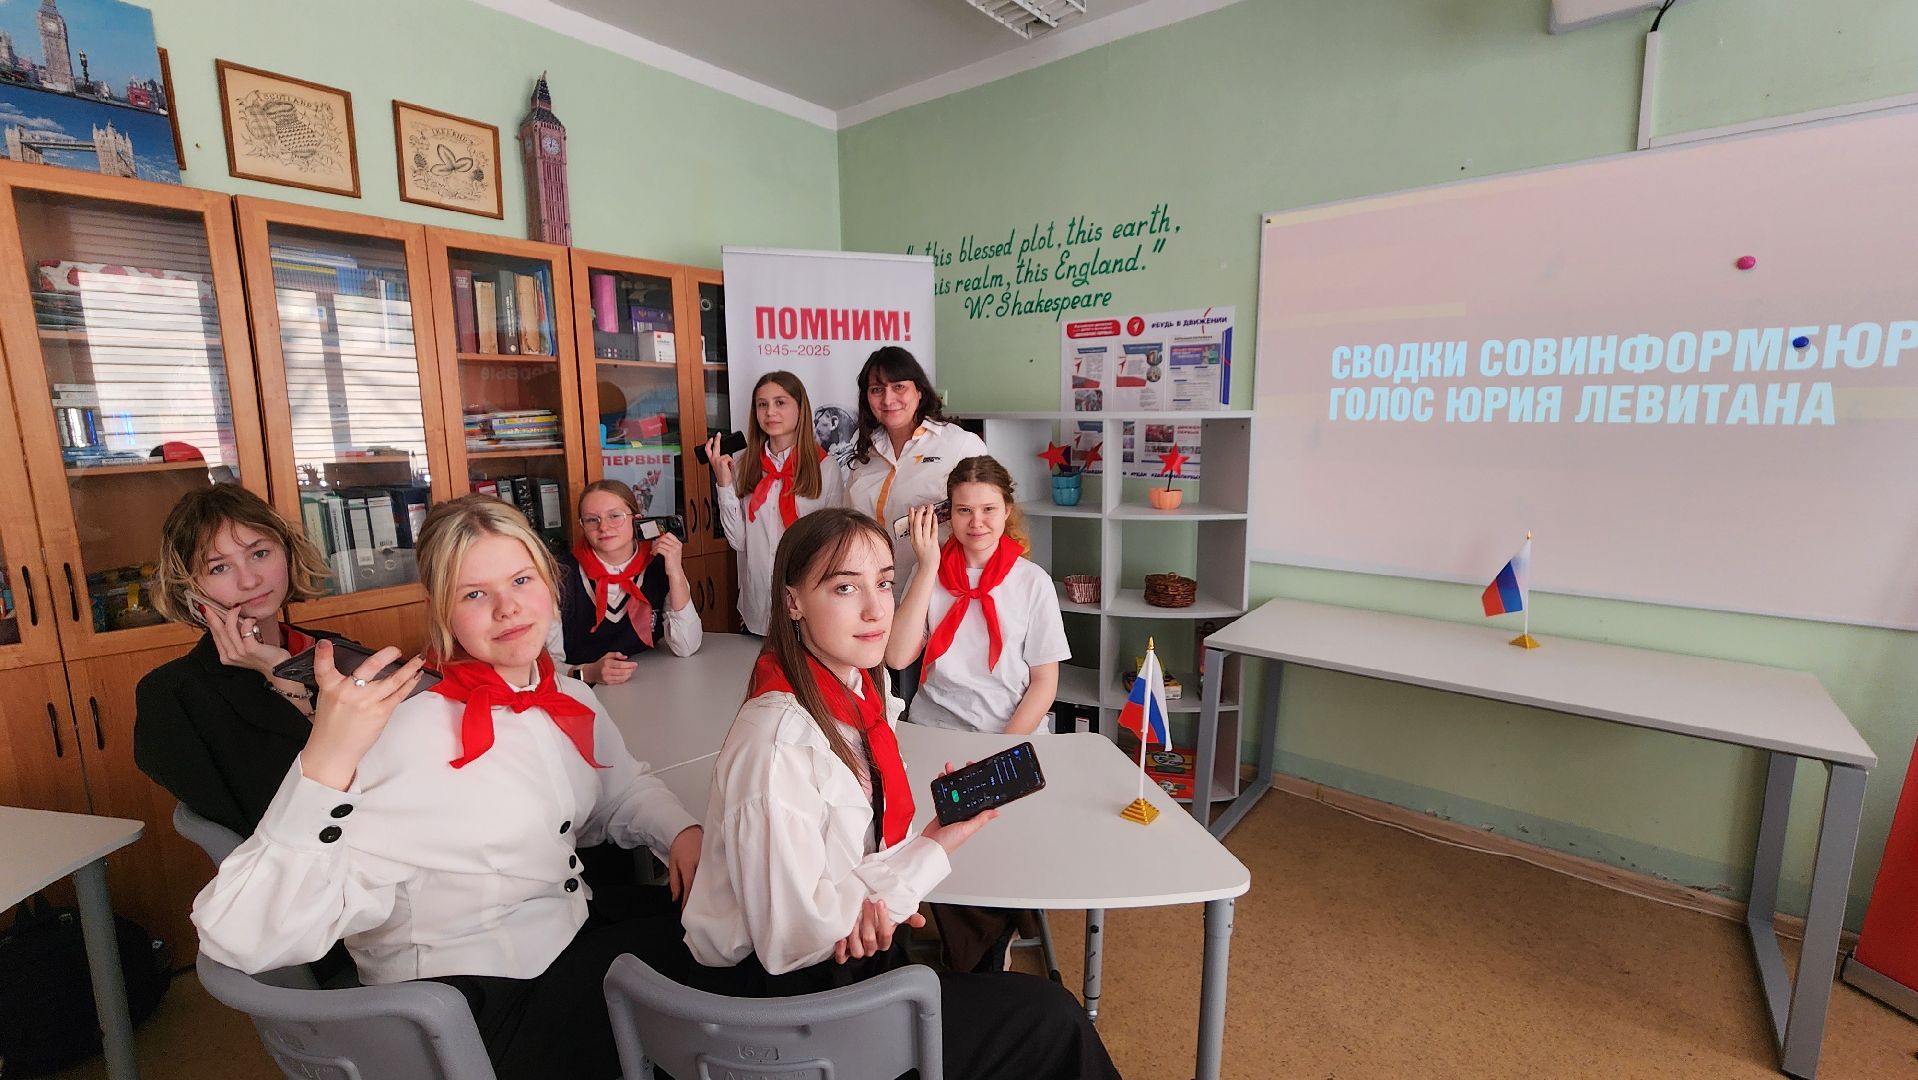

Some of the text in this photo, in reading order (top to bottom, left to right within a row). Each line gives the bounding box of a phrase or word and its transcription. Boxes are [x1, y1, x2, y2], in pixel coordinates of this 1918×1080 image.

[959, 228, 1015, 262] blessed
[1066, 215, 1103, 245] this
[955, 264, 1011, 293] realm,
[1016, 257, 1048, 284] this
[964, 288, 1112, 322] W. Shakespeare
[755, 306, 912, 342] ПОМНИМ!
[1331, 319, 1918, 384] СВОДКИ СОВИНФОРМБЮР
[1328, 382, 1836, 426] ГОЛОС ЮРИЯ ЛЕВИТАНА
[602, 454, 671, 467] ПЕРВЫЕ
